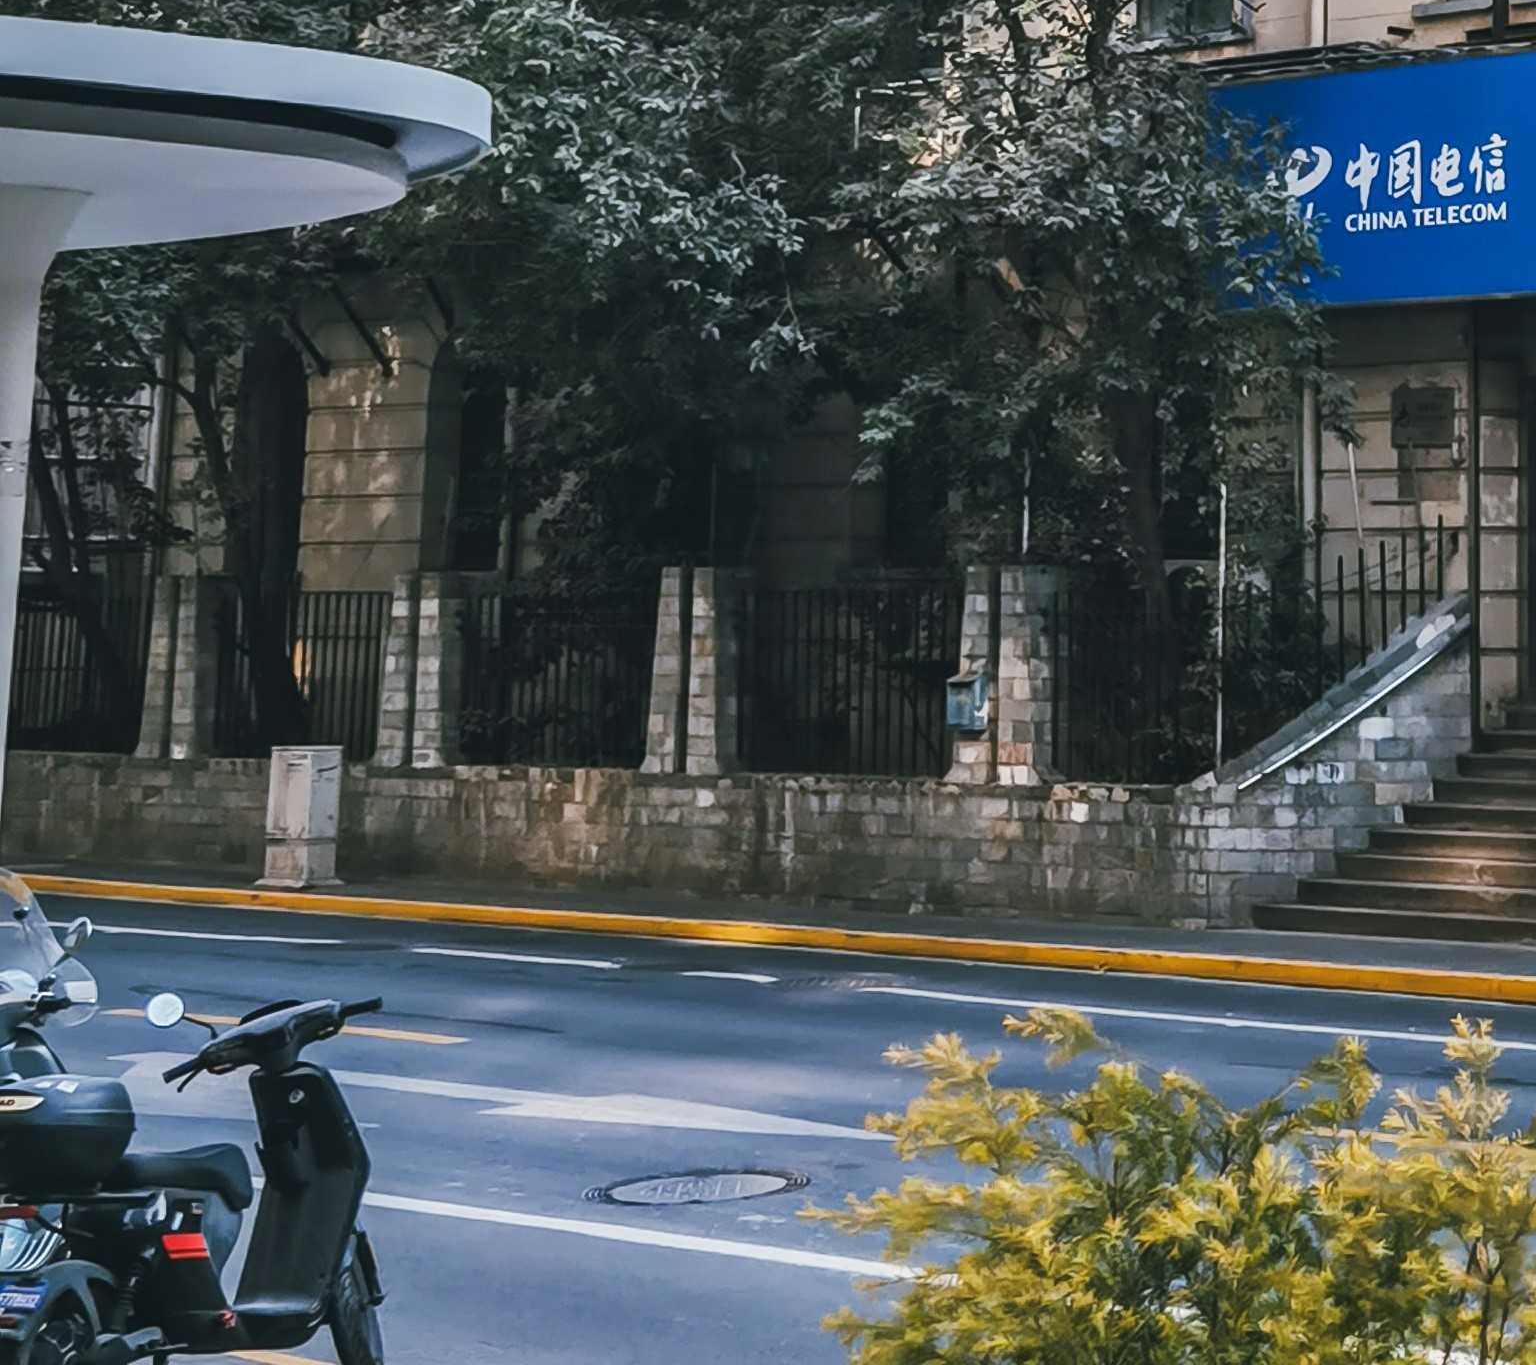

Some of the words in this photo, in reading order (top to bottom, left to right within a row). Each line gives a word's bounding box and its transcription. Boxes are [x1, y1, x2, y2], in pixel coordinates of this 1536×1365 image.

[1345, 133, 1507, 211] 中国电信
[1345, 210, 1407, 232] CHINA
[1412, 201, 1507, 226] TELECOM
